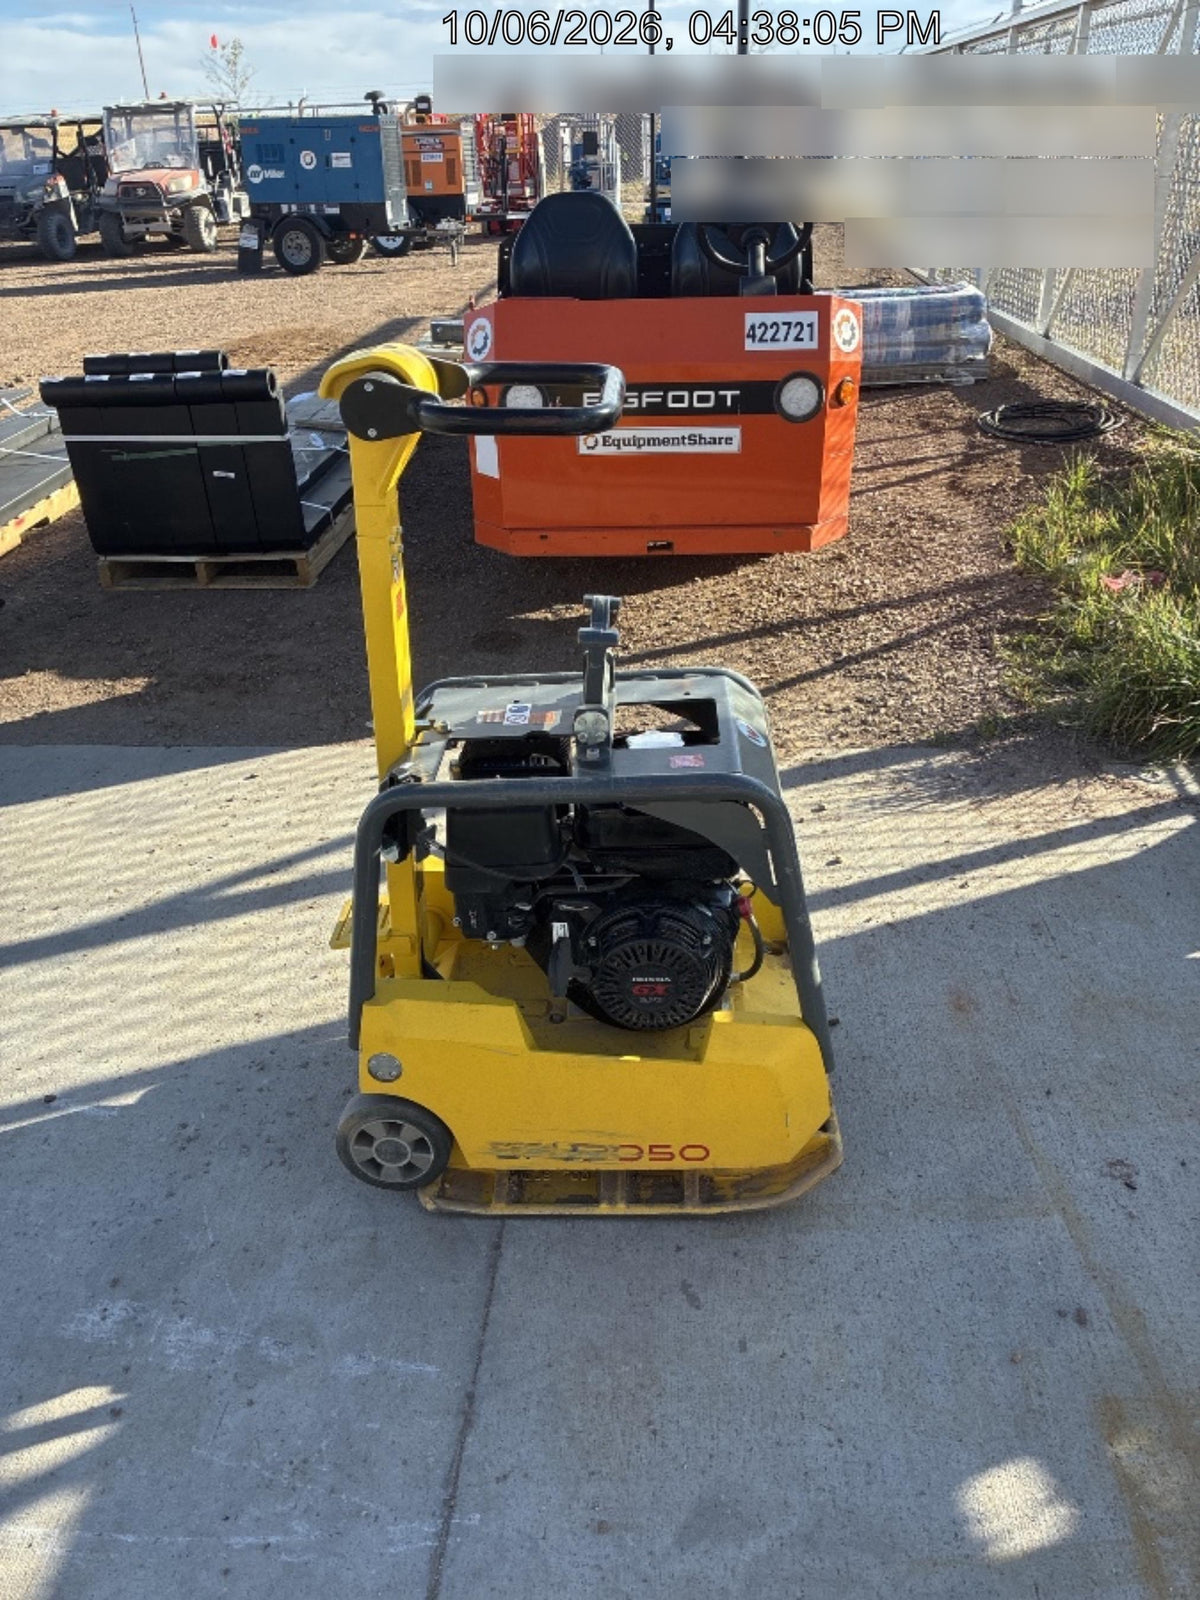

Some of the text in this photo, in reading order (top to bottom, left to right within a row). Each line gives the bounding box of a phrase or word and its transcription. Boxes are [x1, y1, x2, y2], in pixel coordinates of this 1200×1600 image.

[746, 321, 814, 343] 422721
[602, 433, 733, 449] EquipmentShare
[632, 983, 668, 996] GX
